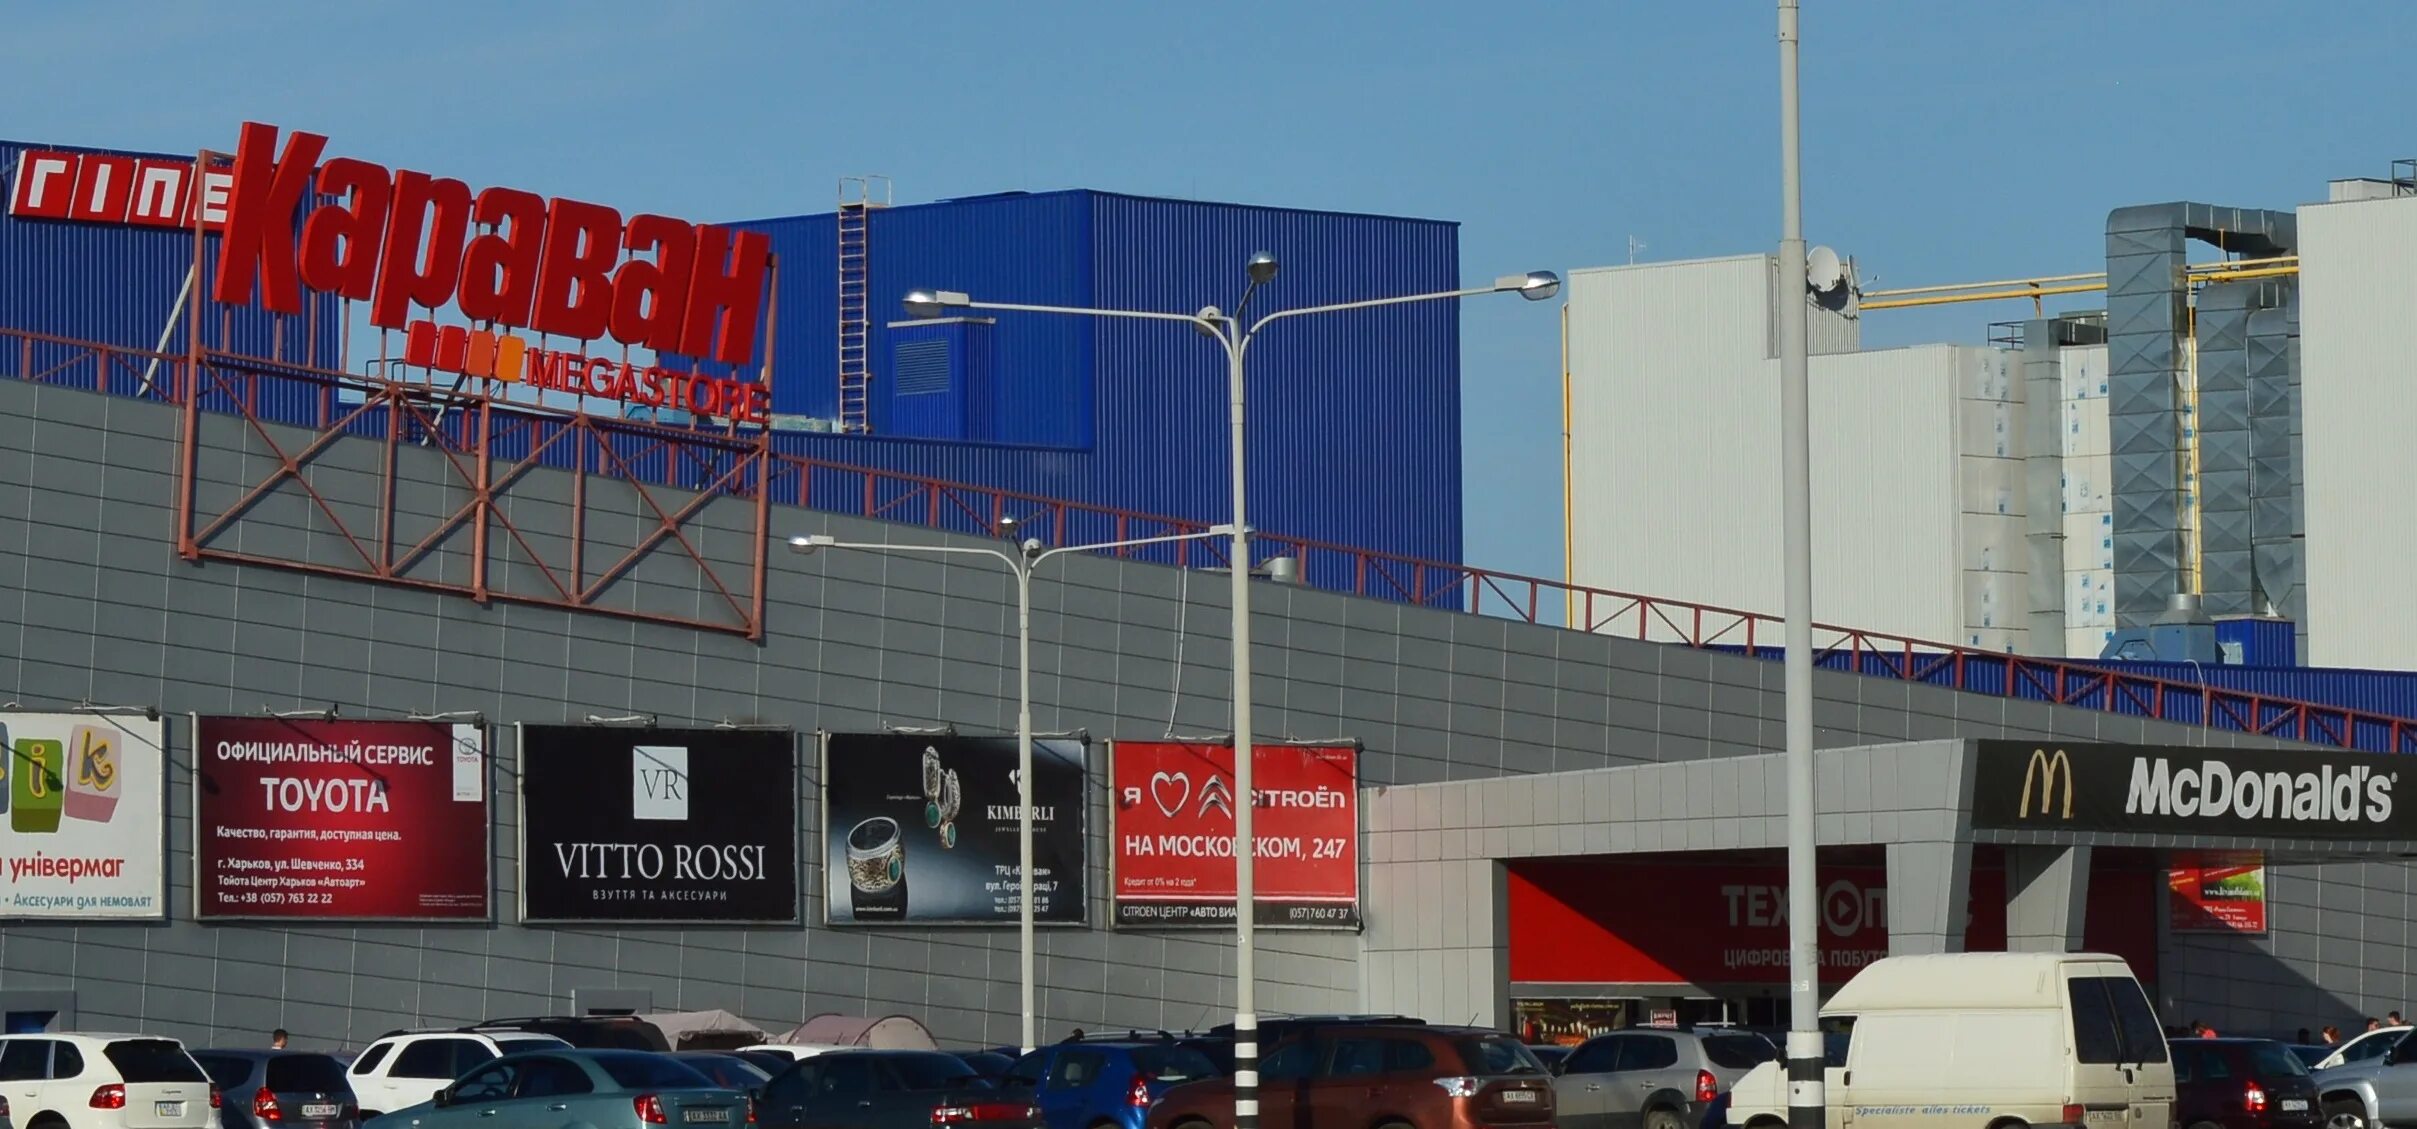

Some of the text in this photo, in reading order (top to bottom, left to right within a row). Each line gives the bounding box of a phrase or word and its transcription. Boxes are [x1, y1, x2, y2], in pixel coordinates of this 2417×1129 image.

[213, 121, 770, 366] Караван
[526, 346, 771, 424] MEGASTORE
[217, 740, 434, 766] ОФИЦИАЛЬНЫЙ СЕРВИС
[640, 768, 682, 800] VR
[2126, 757, 2393, 823] McDonald's
[260, 777, 389, 813] TOYOTA
[1124, 787, 1141, 804] Я
[987, 805, 1055, 820] KIMBRLI
[216, 826, 401, 843] Качество, гарантия, доступная цена.
[1125, 834, 1347, 861] НА МОСКОКОМ, 247
[9, 850, 125, 884] універмаг
[218, 858, 364, 872] г. Харьков, ул. Шевченко, 334
[554, 842, 766, 880] VITTO ROSSI
[995, 865, 1011, 877] ТРЦ
[218, 875, 365, 888] Тойота Центр Харьков «Автоарт»
[1033, 881, 1052, 893] раці,
[1175, 877, 1180, 887] 2
[218, 892, 332, 904] Тел.: +38 (057) 763 22 22
[592, 889, 727, 901] ВЗУТТЯ ТА АКСЕСУАРИ
[1160, 906, 1188, 919] ЦЕНТР
[1190, 907, 1217, 918] «АВТО
[1290, 907, 1349, 920] (057) 760 47 37
[1724, 949, 1791, 969] ЦИФРОВ
